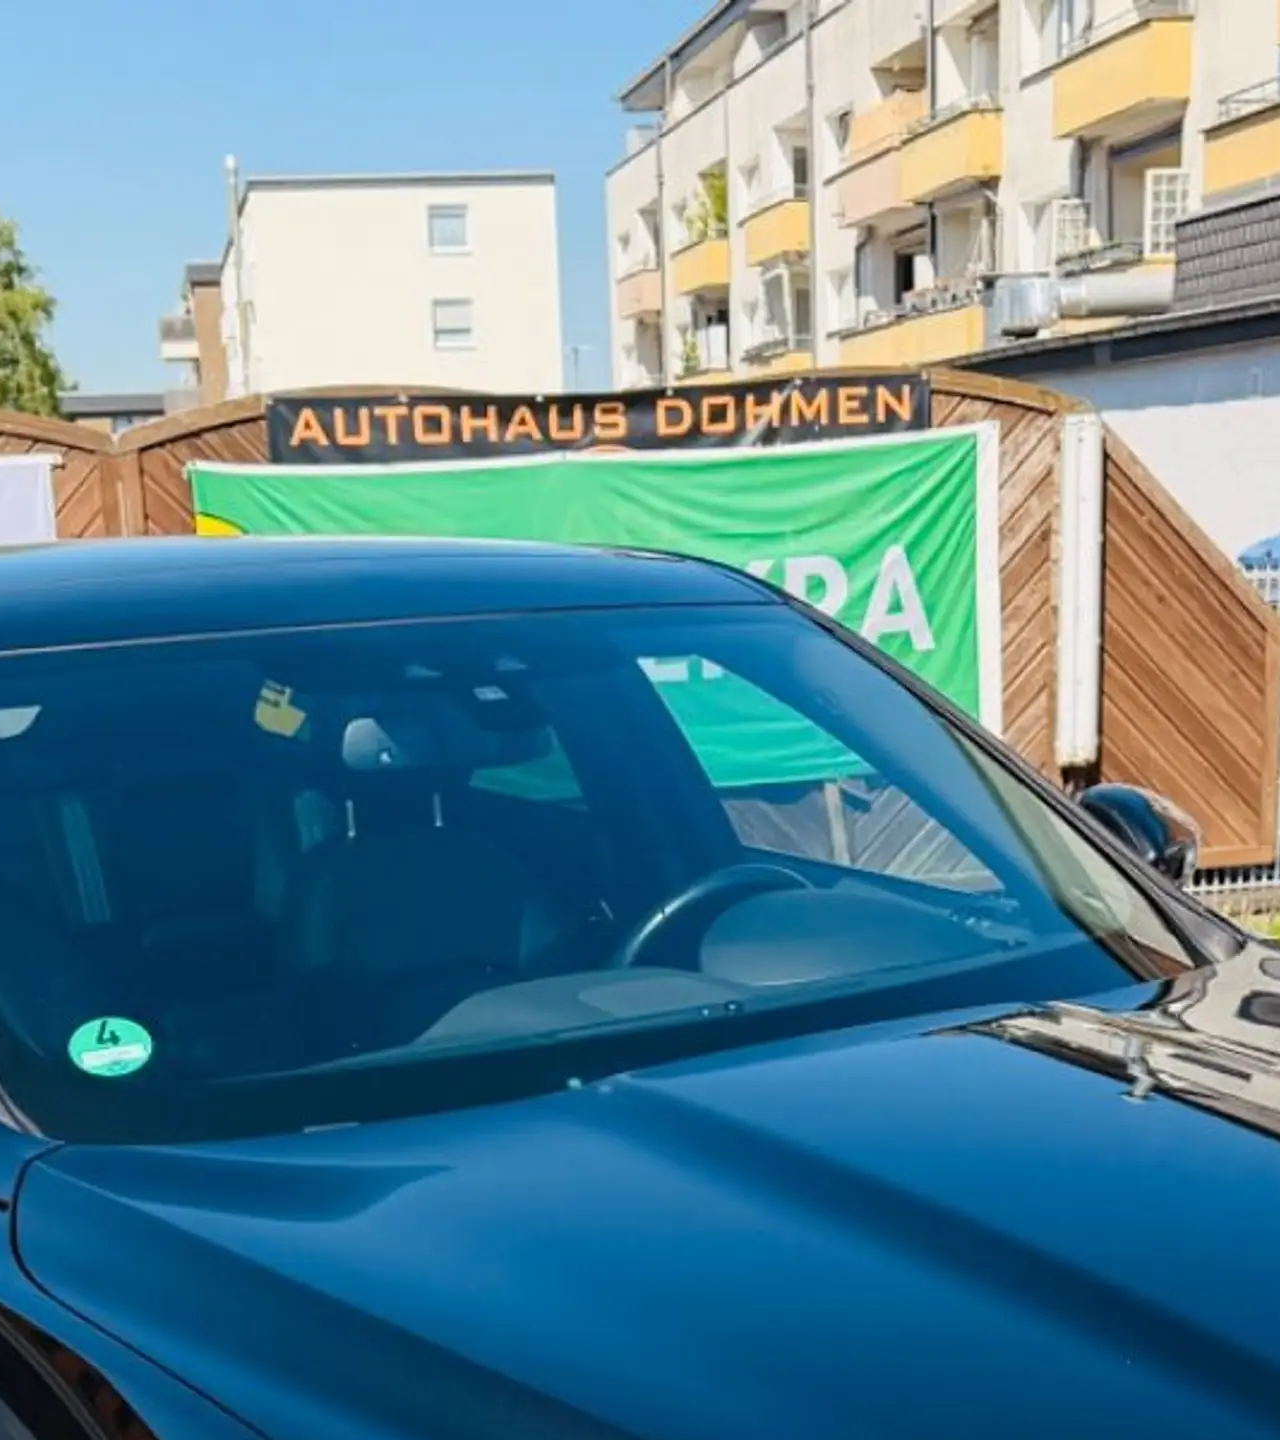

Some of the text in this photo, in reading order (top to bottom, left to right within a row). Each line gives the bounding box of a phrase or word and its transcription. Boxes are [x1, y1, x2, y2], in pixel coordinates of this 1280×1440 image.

[289, 382, 913, 448] AUTOHAUS DOHMEN
[96, 1019, 121, 1046] 4
